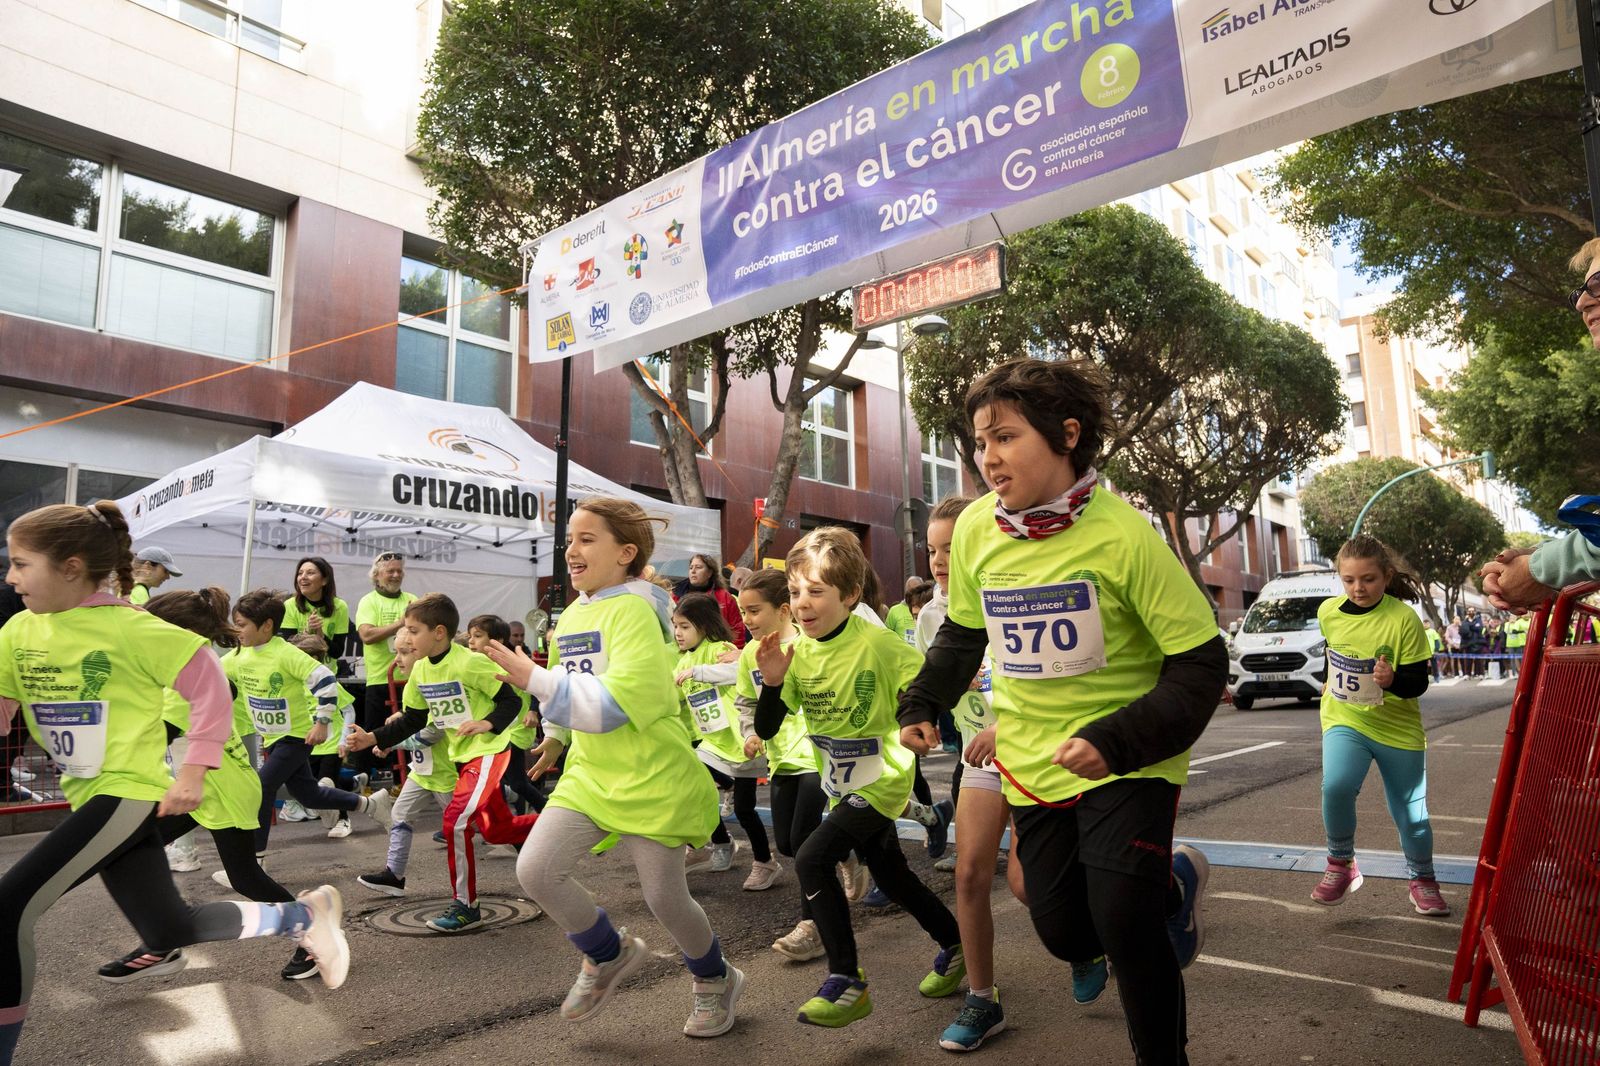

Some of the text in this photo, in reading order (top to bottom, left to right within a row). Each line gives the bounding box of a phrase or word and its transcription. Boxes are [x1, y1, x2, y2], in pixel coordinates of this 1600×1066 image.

[1202, 4, 1266, 43] Isabel
[885, 78, 936, 120] en
[952, 0, 1134, 95] marcha
[1099, 55, 1119, 87] 8
[1224, 27, 1351, 95] LEALTADIS
[1251, 62, 1323, 96] ABOGADOS
[1040, 105, 1149, 152] asociación española
[1042, 127, 1126, 164] contra el cáncer
[733, 80, 1062, 238] contra el cáncer
[1044, 150, 1105, 177] en Almería
[879, 188, 938, 232] 2026
[734, 234, 839, 280] #TodosContraElCáncer
[992, 601, 1064, 614] contra el cáncer
[1002, 618, 1078, 654] 570
[1335, 672, 1361, 692] 15
[50, 730, 74, 757] 30
[834, 749, 860, 757] cáncer
